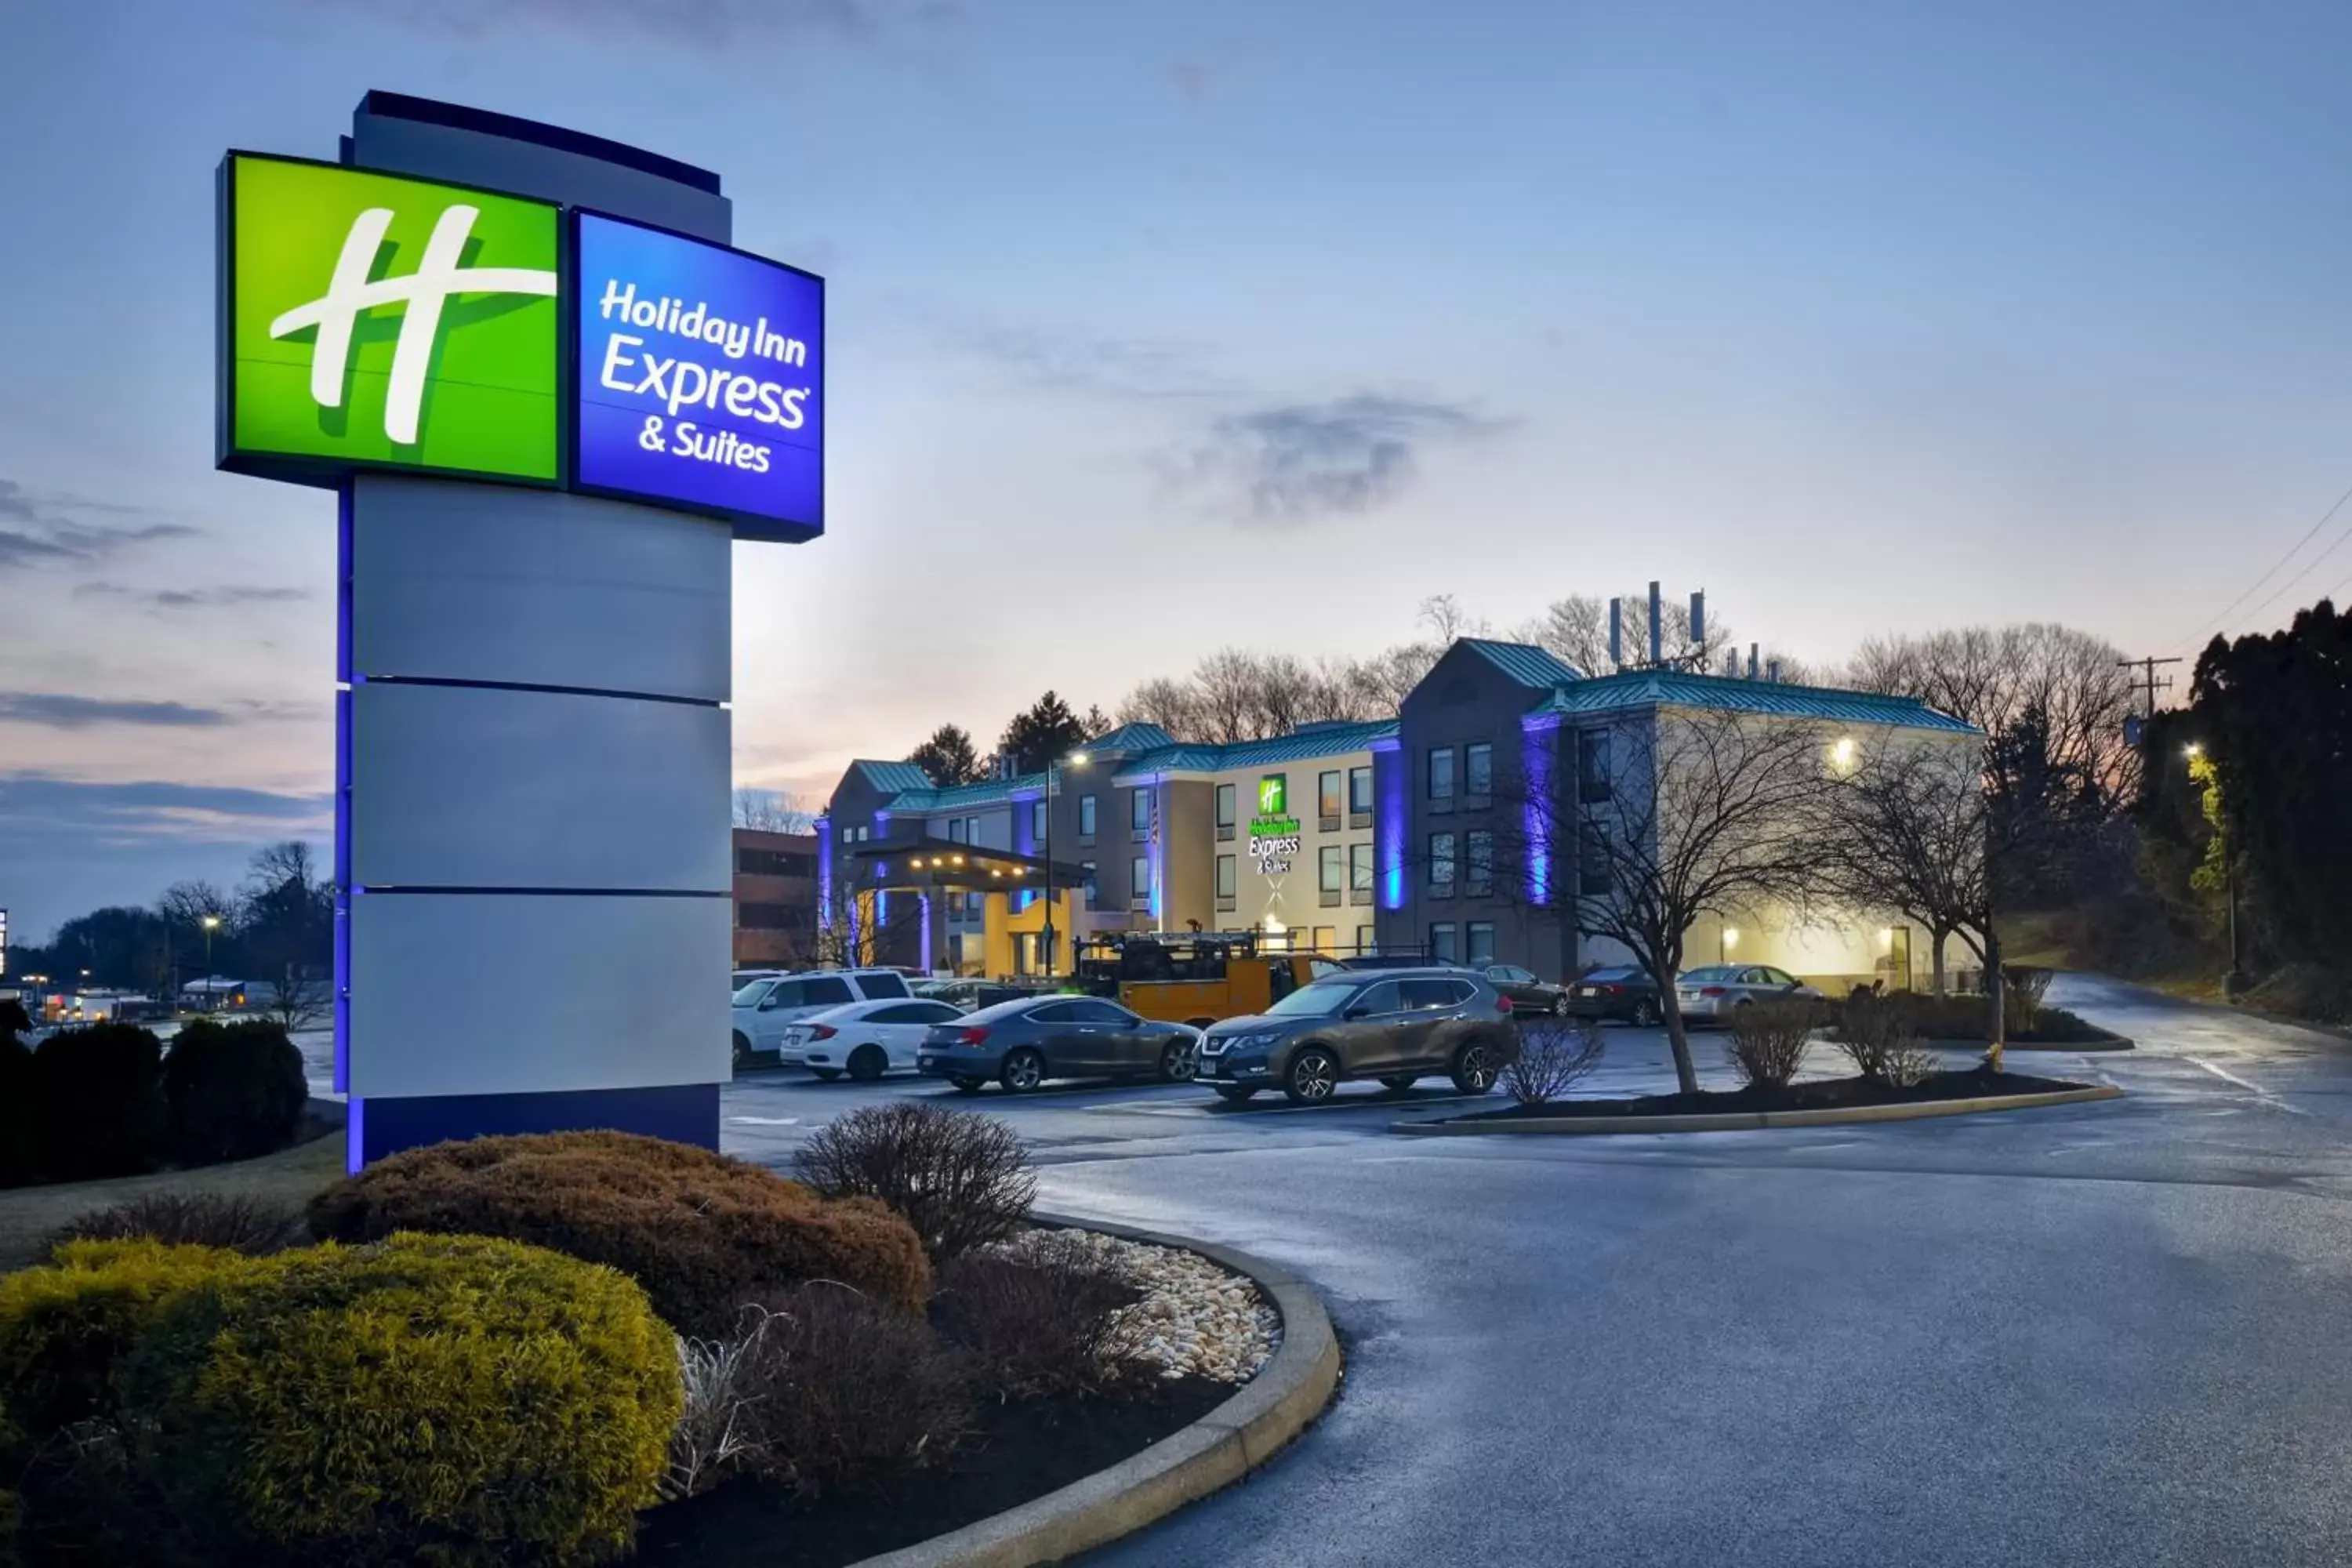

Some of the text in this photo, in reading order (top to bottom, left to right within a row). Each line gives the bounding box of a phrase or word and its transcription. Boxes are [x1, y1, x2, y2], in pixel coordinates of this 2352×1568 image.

[270, 204, 557, 445] H
[599, 278, 807, 368] Holiday Inn
[600, 332, 807, 430] Express
[638, 415, 771, 474] & Suites
[1249, 836, 1300, 861] Express
